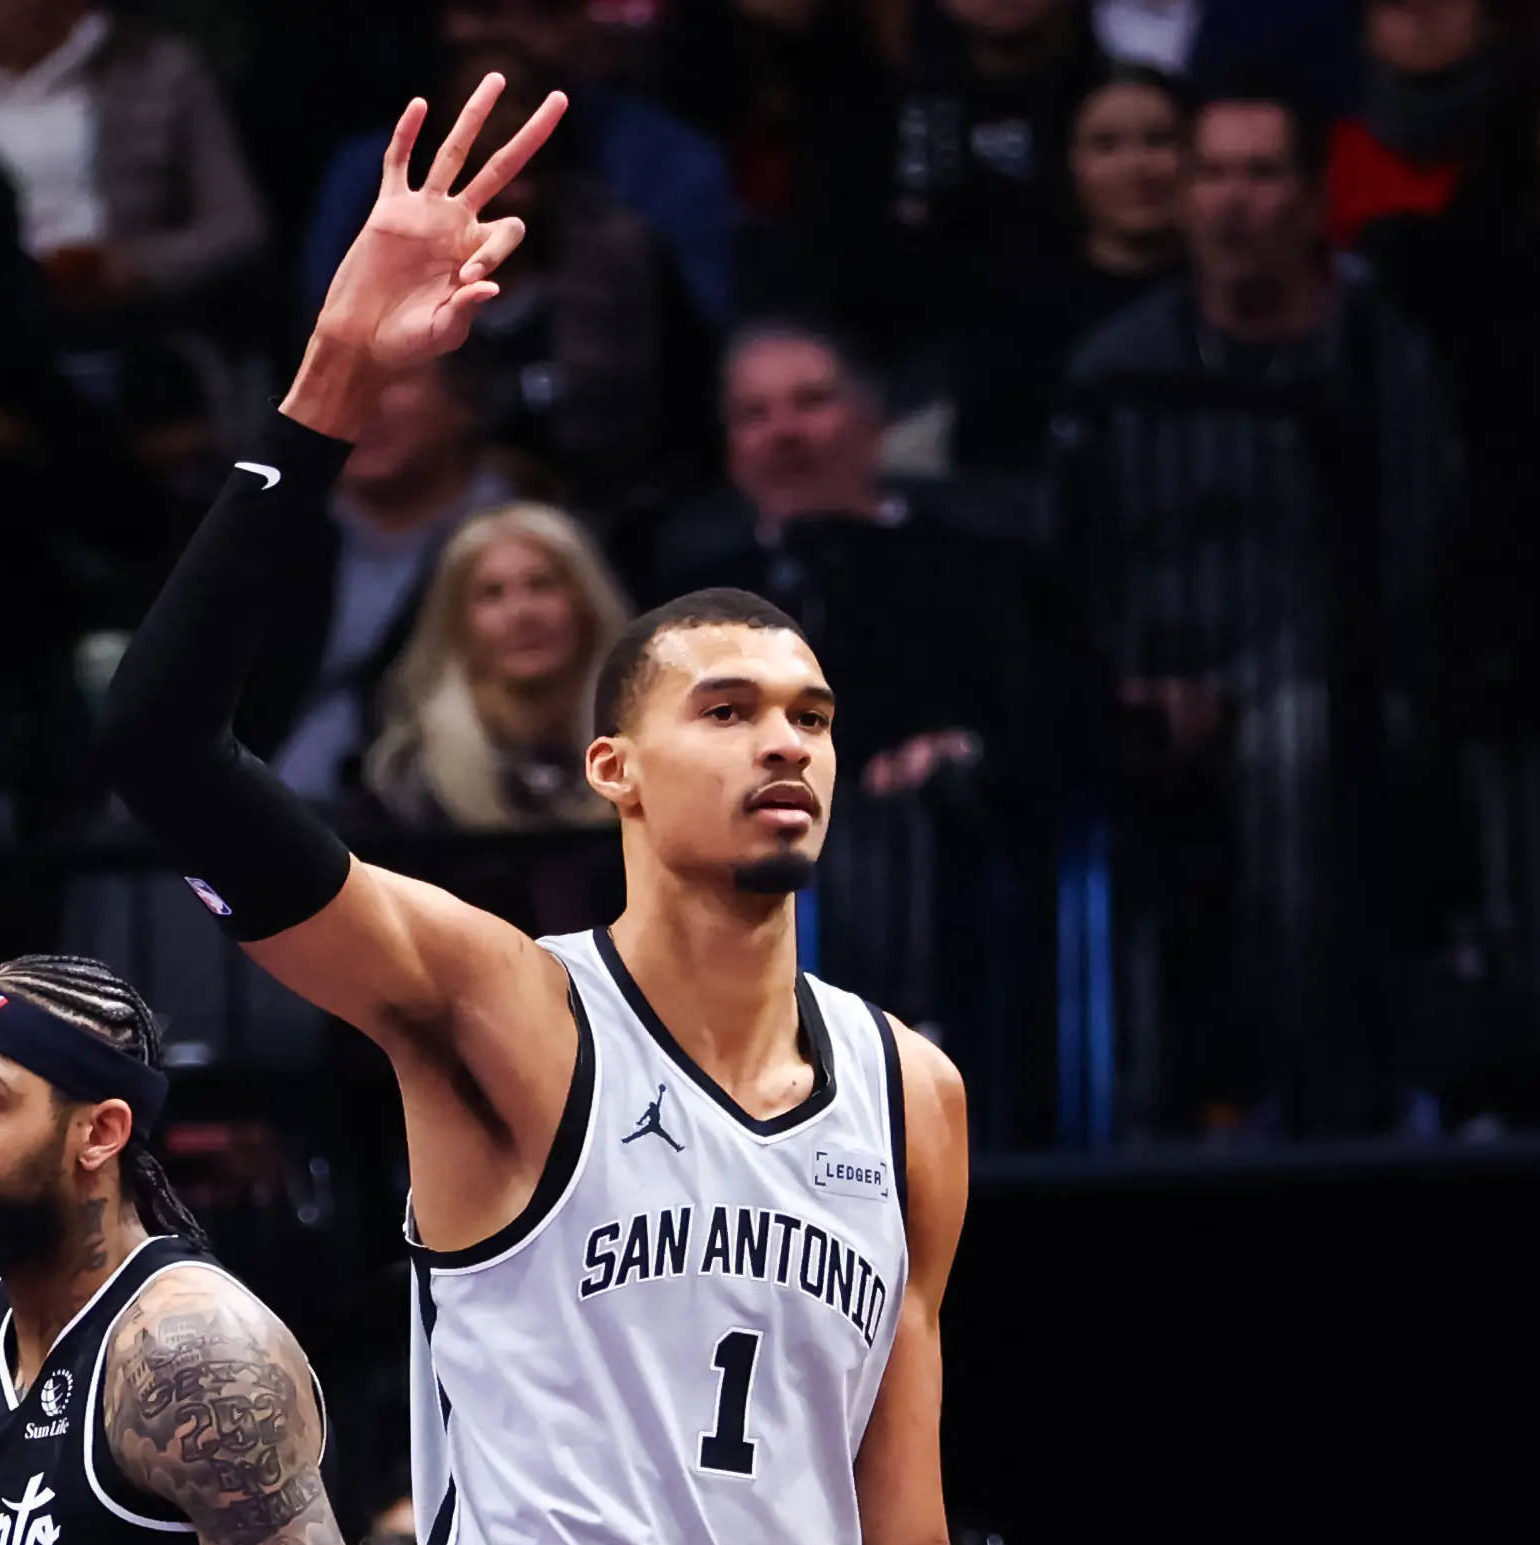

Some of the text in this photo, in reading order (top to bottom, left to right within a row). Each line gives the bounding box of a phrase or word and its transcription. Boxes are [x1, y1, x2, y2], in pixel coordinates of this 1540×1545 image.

[825, 1162, 882, 1186] LEDGER
[579, 1204, 887, 1350] SAN ANTONIO
[24, 1417, 70, 1440] Sun Life
[696, 1326, 764, 1480] 1
